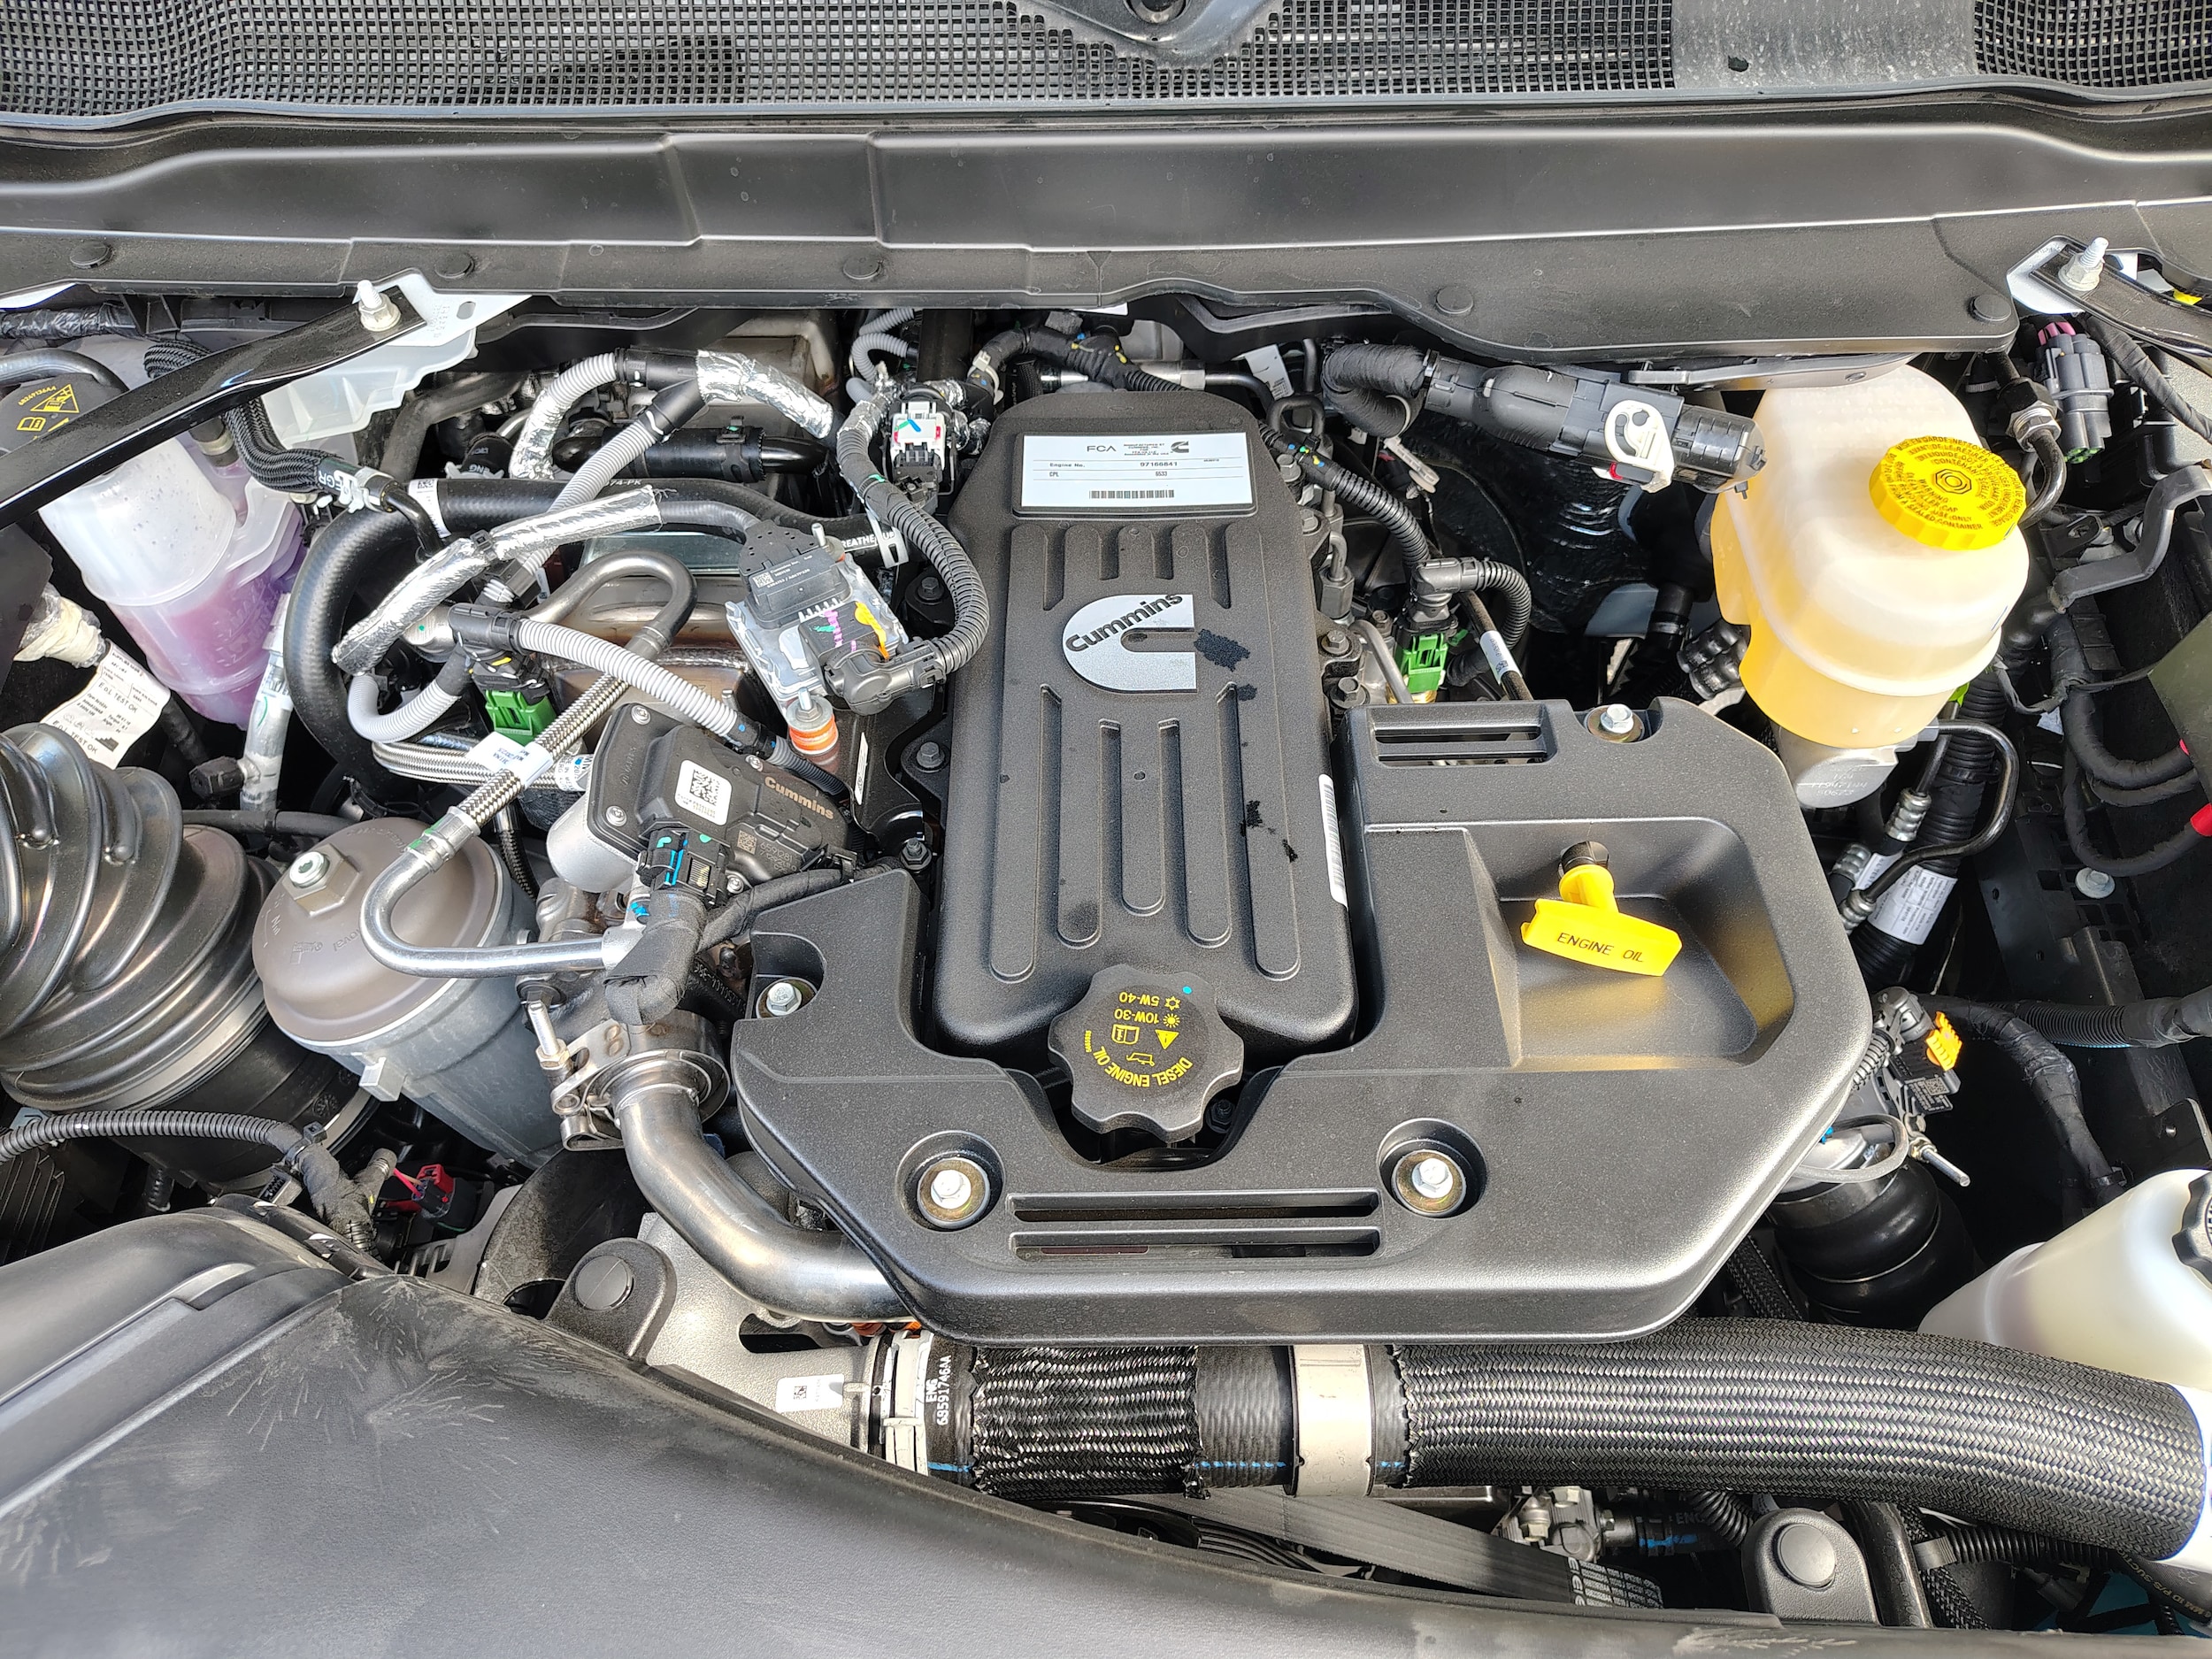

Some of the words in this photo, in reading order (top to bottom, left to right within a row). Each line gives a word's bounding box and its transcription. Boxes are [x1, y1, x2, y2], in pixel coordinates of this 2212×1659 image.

[1936, 518, 1983, 530] CONTAINER
[841, 534, 874, 548] REATHE
[1065, 594, 1183, 652] Cummins
[113, 692, 128, 706] TEST
[128, 704, 138, 713] OK
[88, 743, 98, 754] OK
[764, 776, 834, 820] Cummins
[1557, 932, 1615, 956] ENGINE
[1622, 949, 1644, 963] OIL
[1118, 991, 1160, 1007] 5W-40
[1114, 1008, 1159, 1025] 10W-30
[1093, 1046, 1111, 1066] OIL
[1104, 1062, 1150, 1087] ENGINE
[1152, 1056, 1194, 1086] DIESEL
[926, 1379, 938, 1402] ENG
